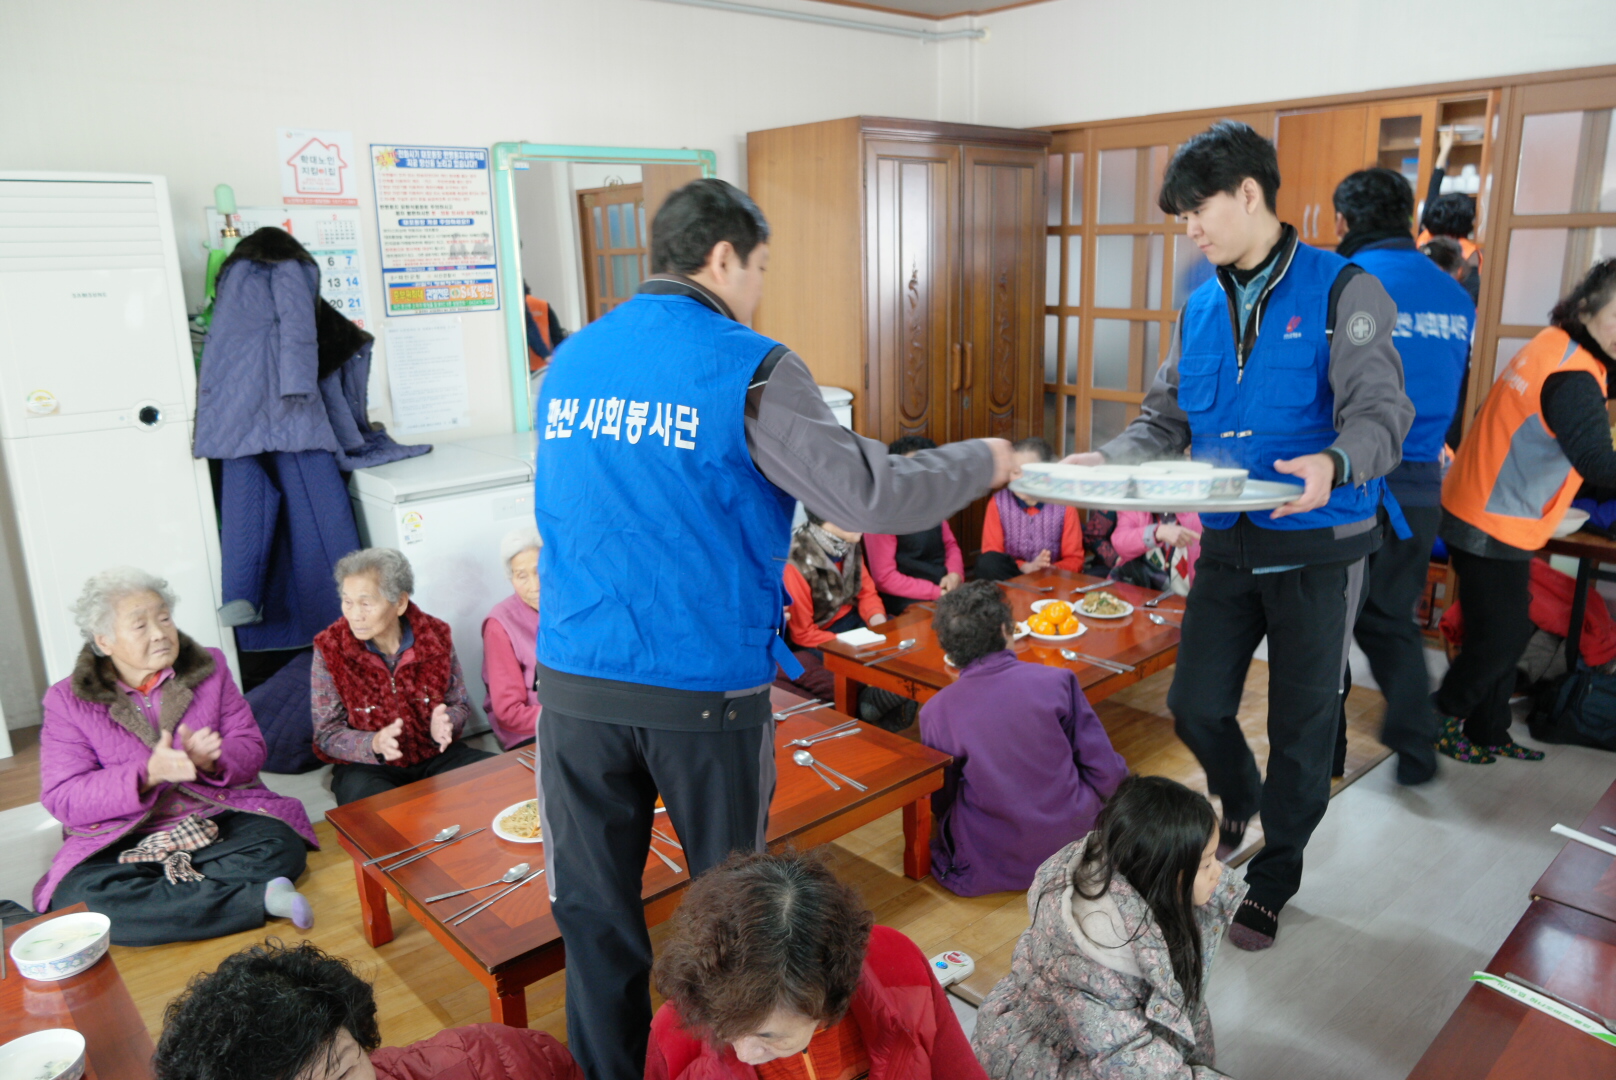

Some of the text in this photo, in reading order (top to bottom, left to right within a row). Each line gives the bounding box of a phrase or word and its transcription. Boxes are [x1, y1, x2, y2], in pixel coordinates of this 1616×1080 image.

[300, 155, 335, 166] 학대노인
[327, 256, 352, 267] 6 7
[327, 277, 359, 288] 13 14
[330, 298, 361, 309] 20 21
[579, 396, 700, 450] 사회봉사단
